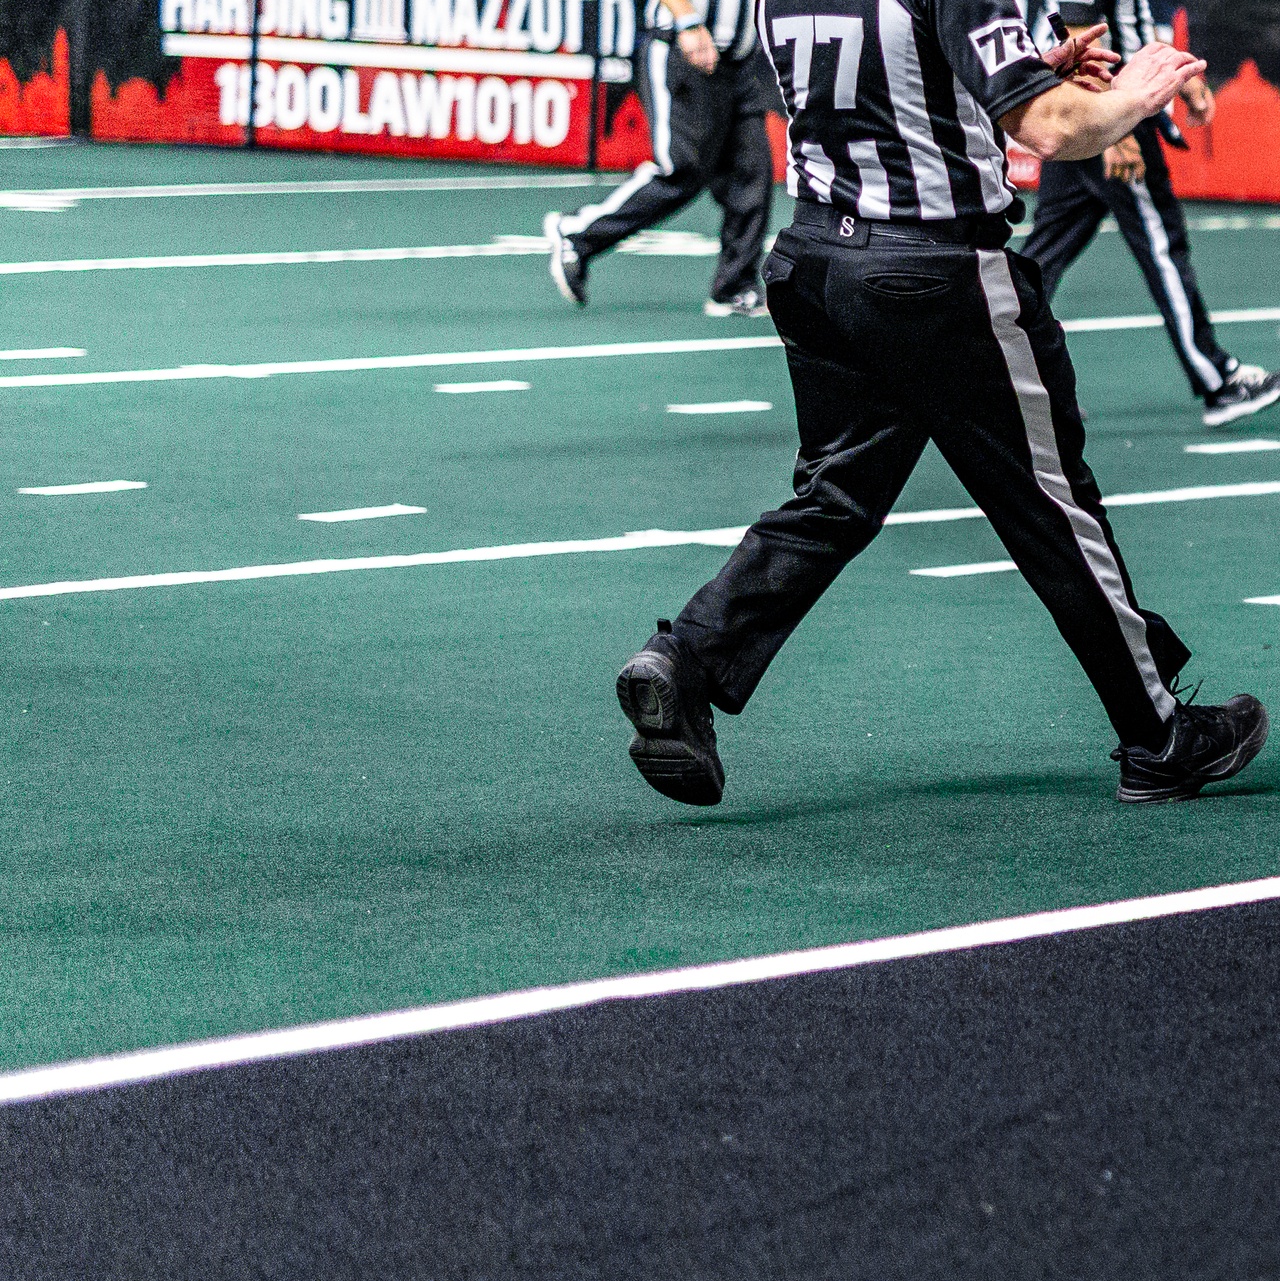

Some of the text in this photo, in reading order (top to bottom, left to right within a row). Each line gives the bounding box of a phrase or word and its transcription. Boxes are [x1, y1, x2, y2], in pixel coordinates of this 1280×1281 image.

[771, 15, 864, 110] 77
[977, 24, 1030, 67] 77
[840, 216, 854, 237] S
